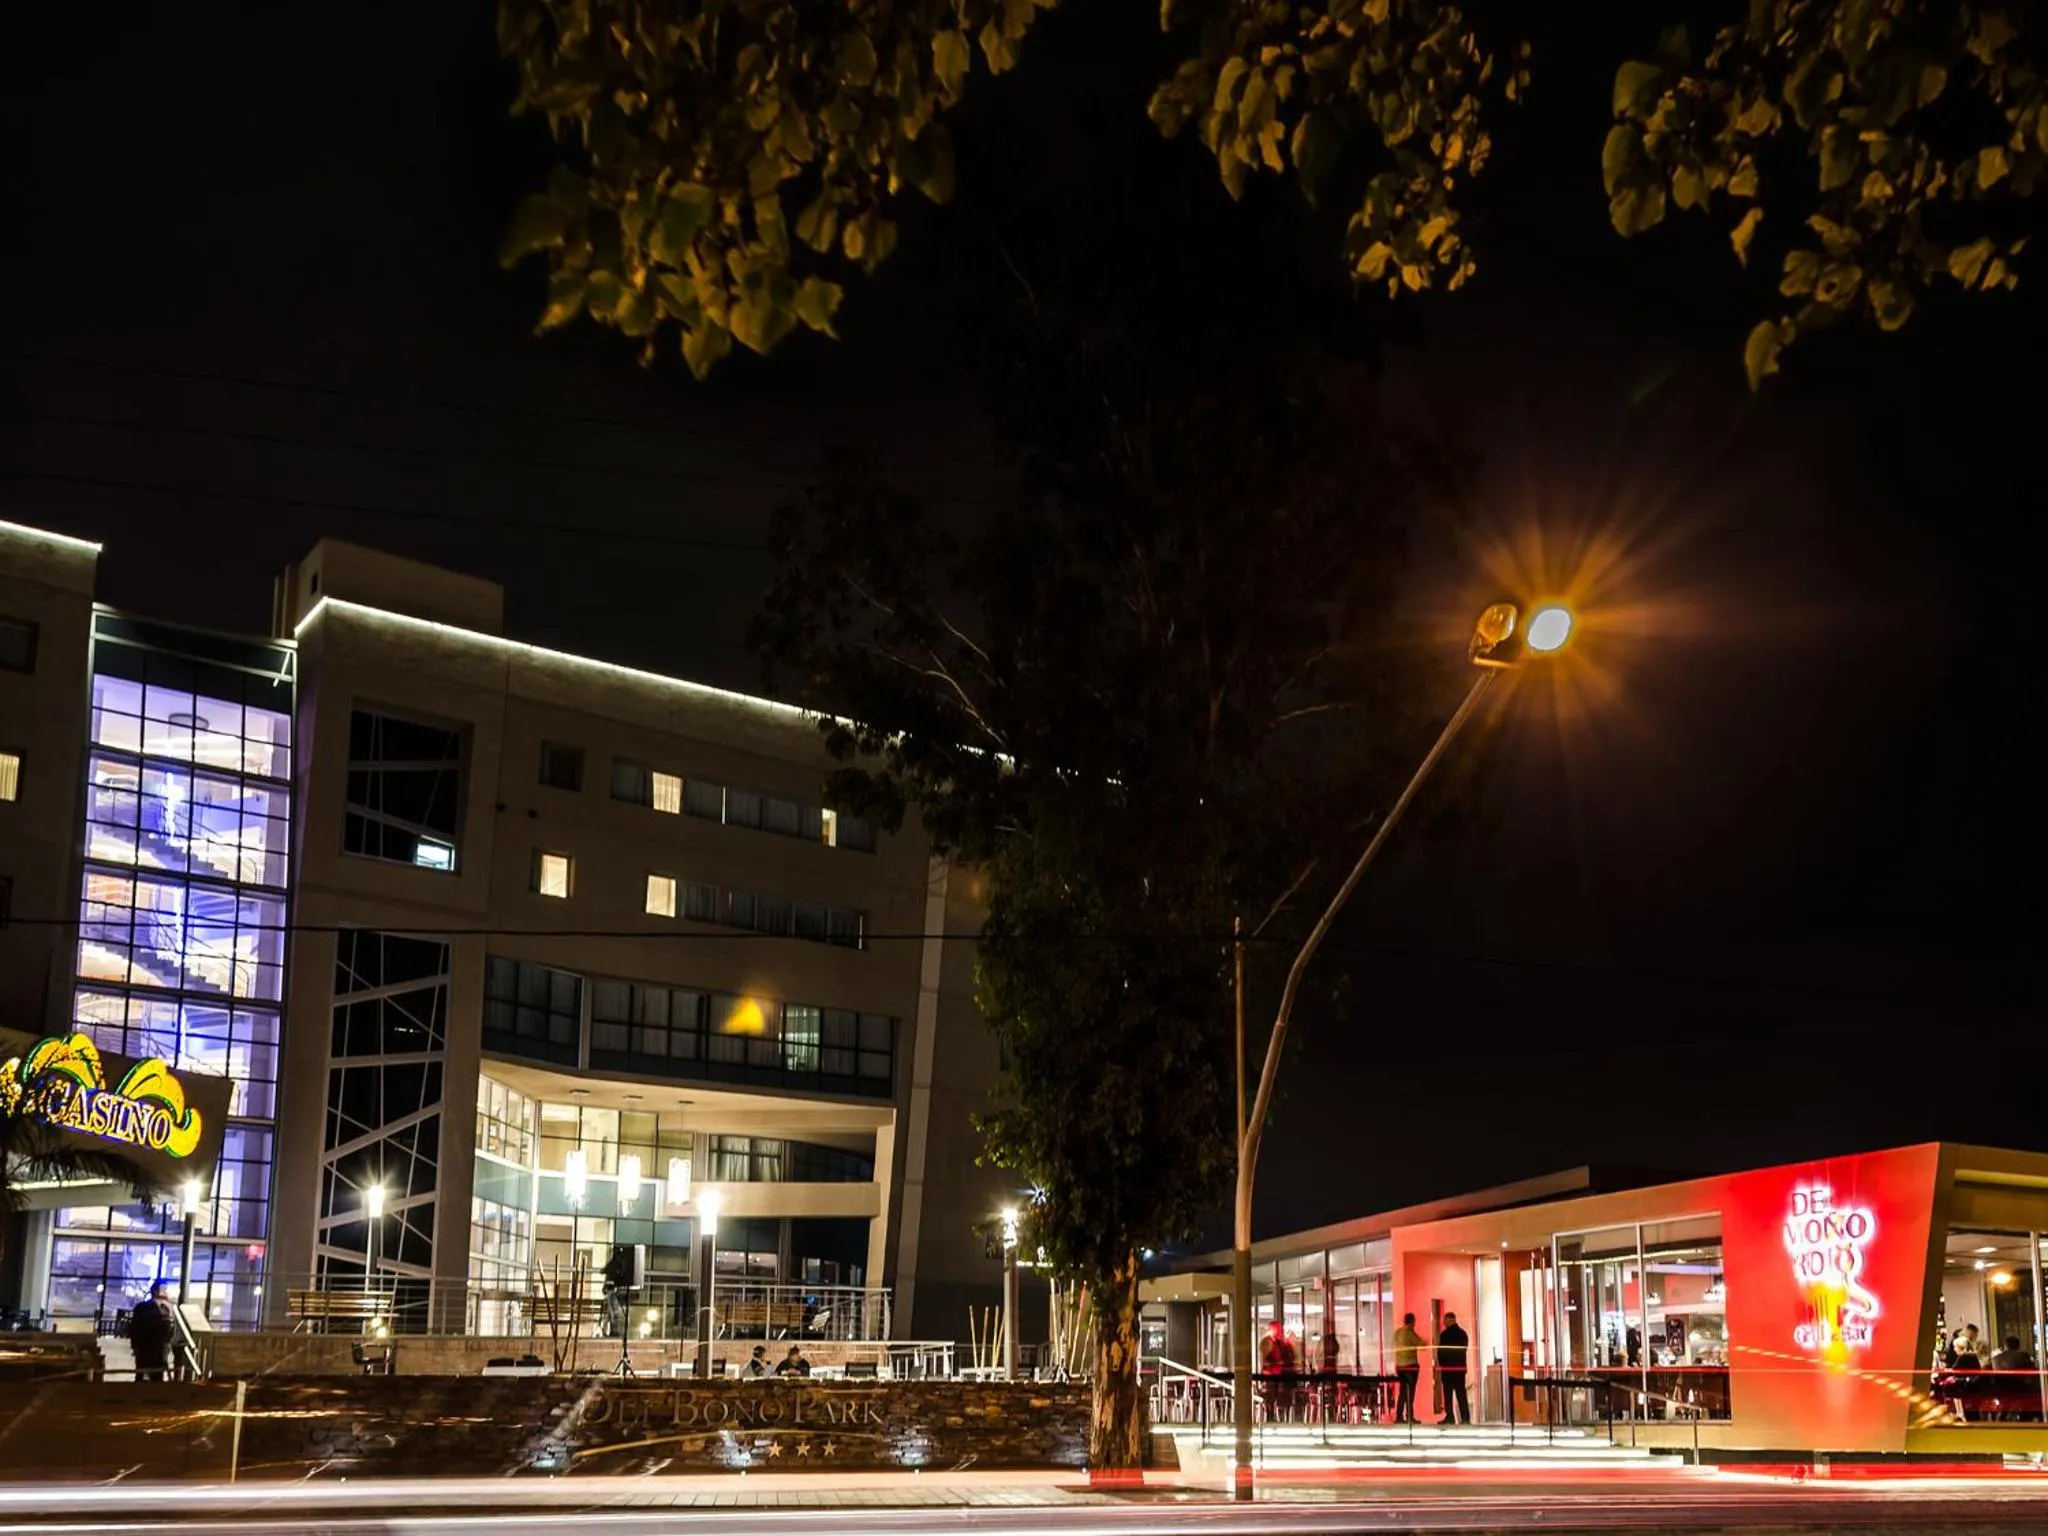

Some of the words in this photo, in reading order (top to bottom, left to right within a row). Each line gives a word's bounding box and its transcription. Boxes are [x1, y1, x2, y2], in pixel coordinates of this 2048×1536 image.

[46, 1078, 172, 1149] CASINO
[671, 1388, 784, 1427] BONO
[793, 1387, 884, 1426] PARK
